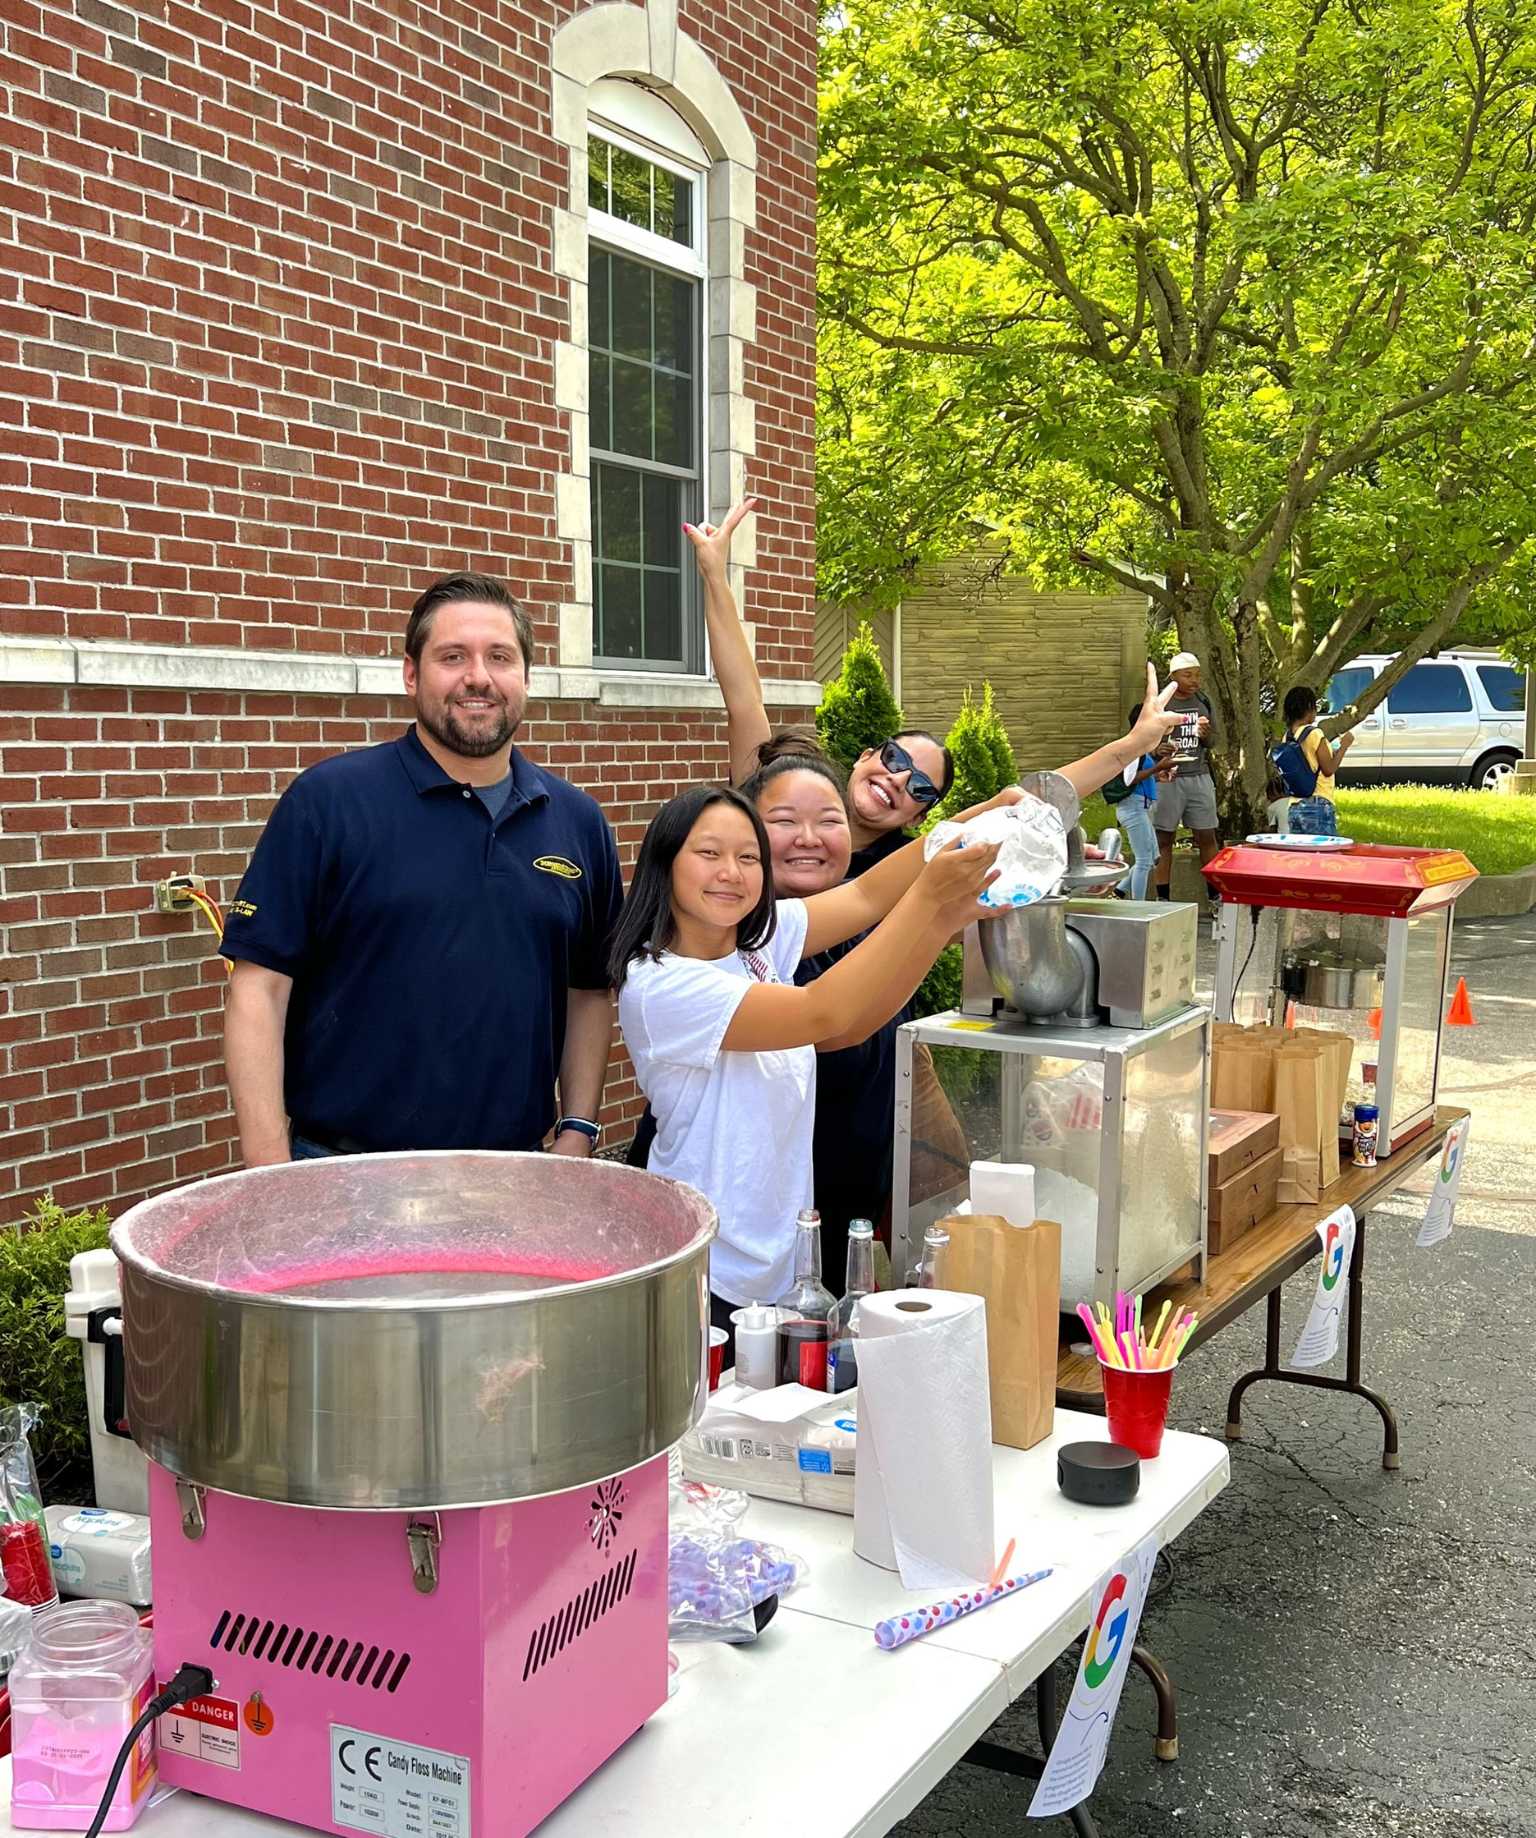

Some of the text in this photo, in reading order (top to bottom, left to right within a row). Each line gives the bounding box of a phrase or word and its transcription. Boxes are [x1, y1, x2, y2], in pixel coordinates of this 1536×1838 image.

[1175, 737, 1199, 748] ROAD
[1322, 1223, 1344, 1291] G
[1084, 1573, 1129, 1689] G
[192, 1702, 234, 1721] DANGER
[339, 1740, 382, 1782] CE
[388, 1752, 462, 1785] Candy Floss Machine
